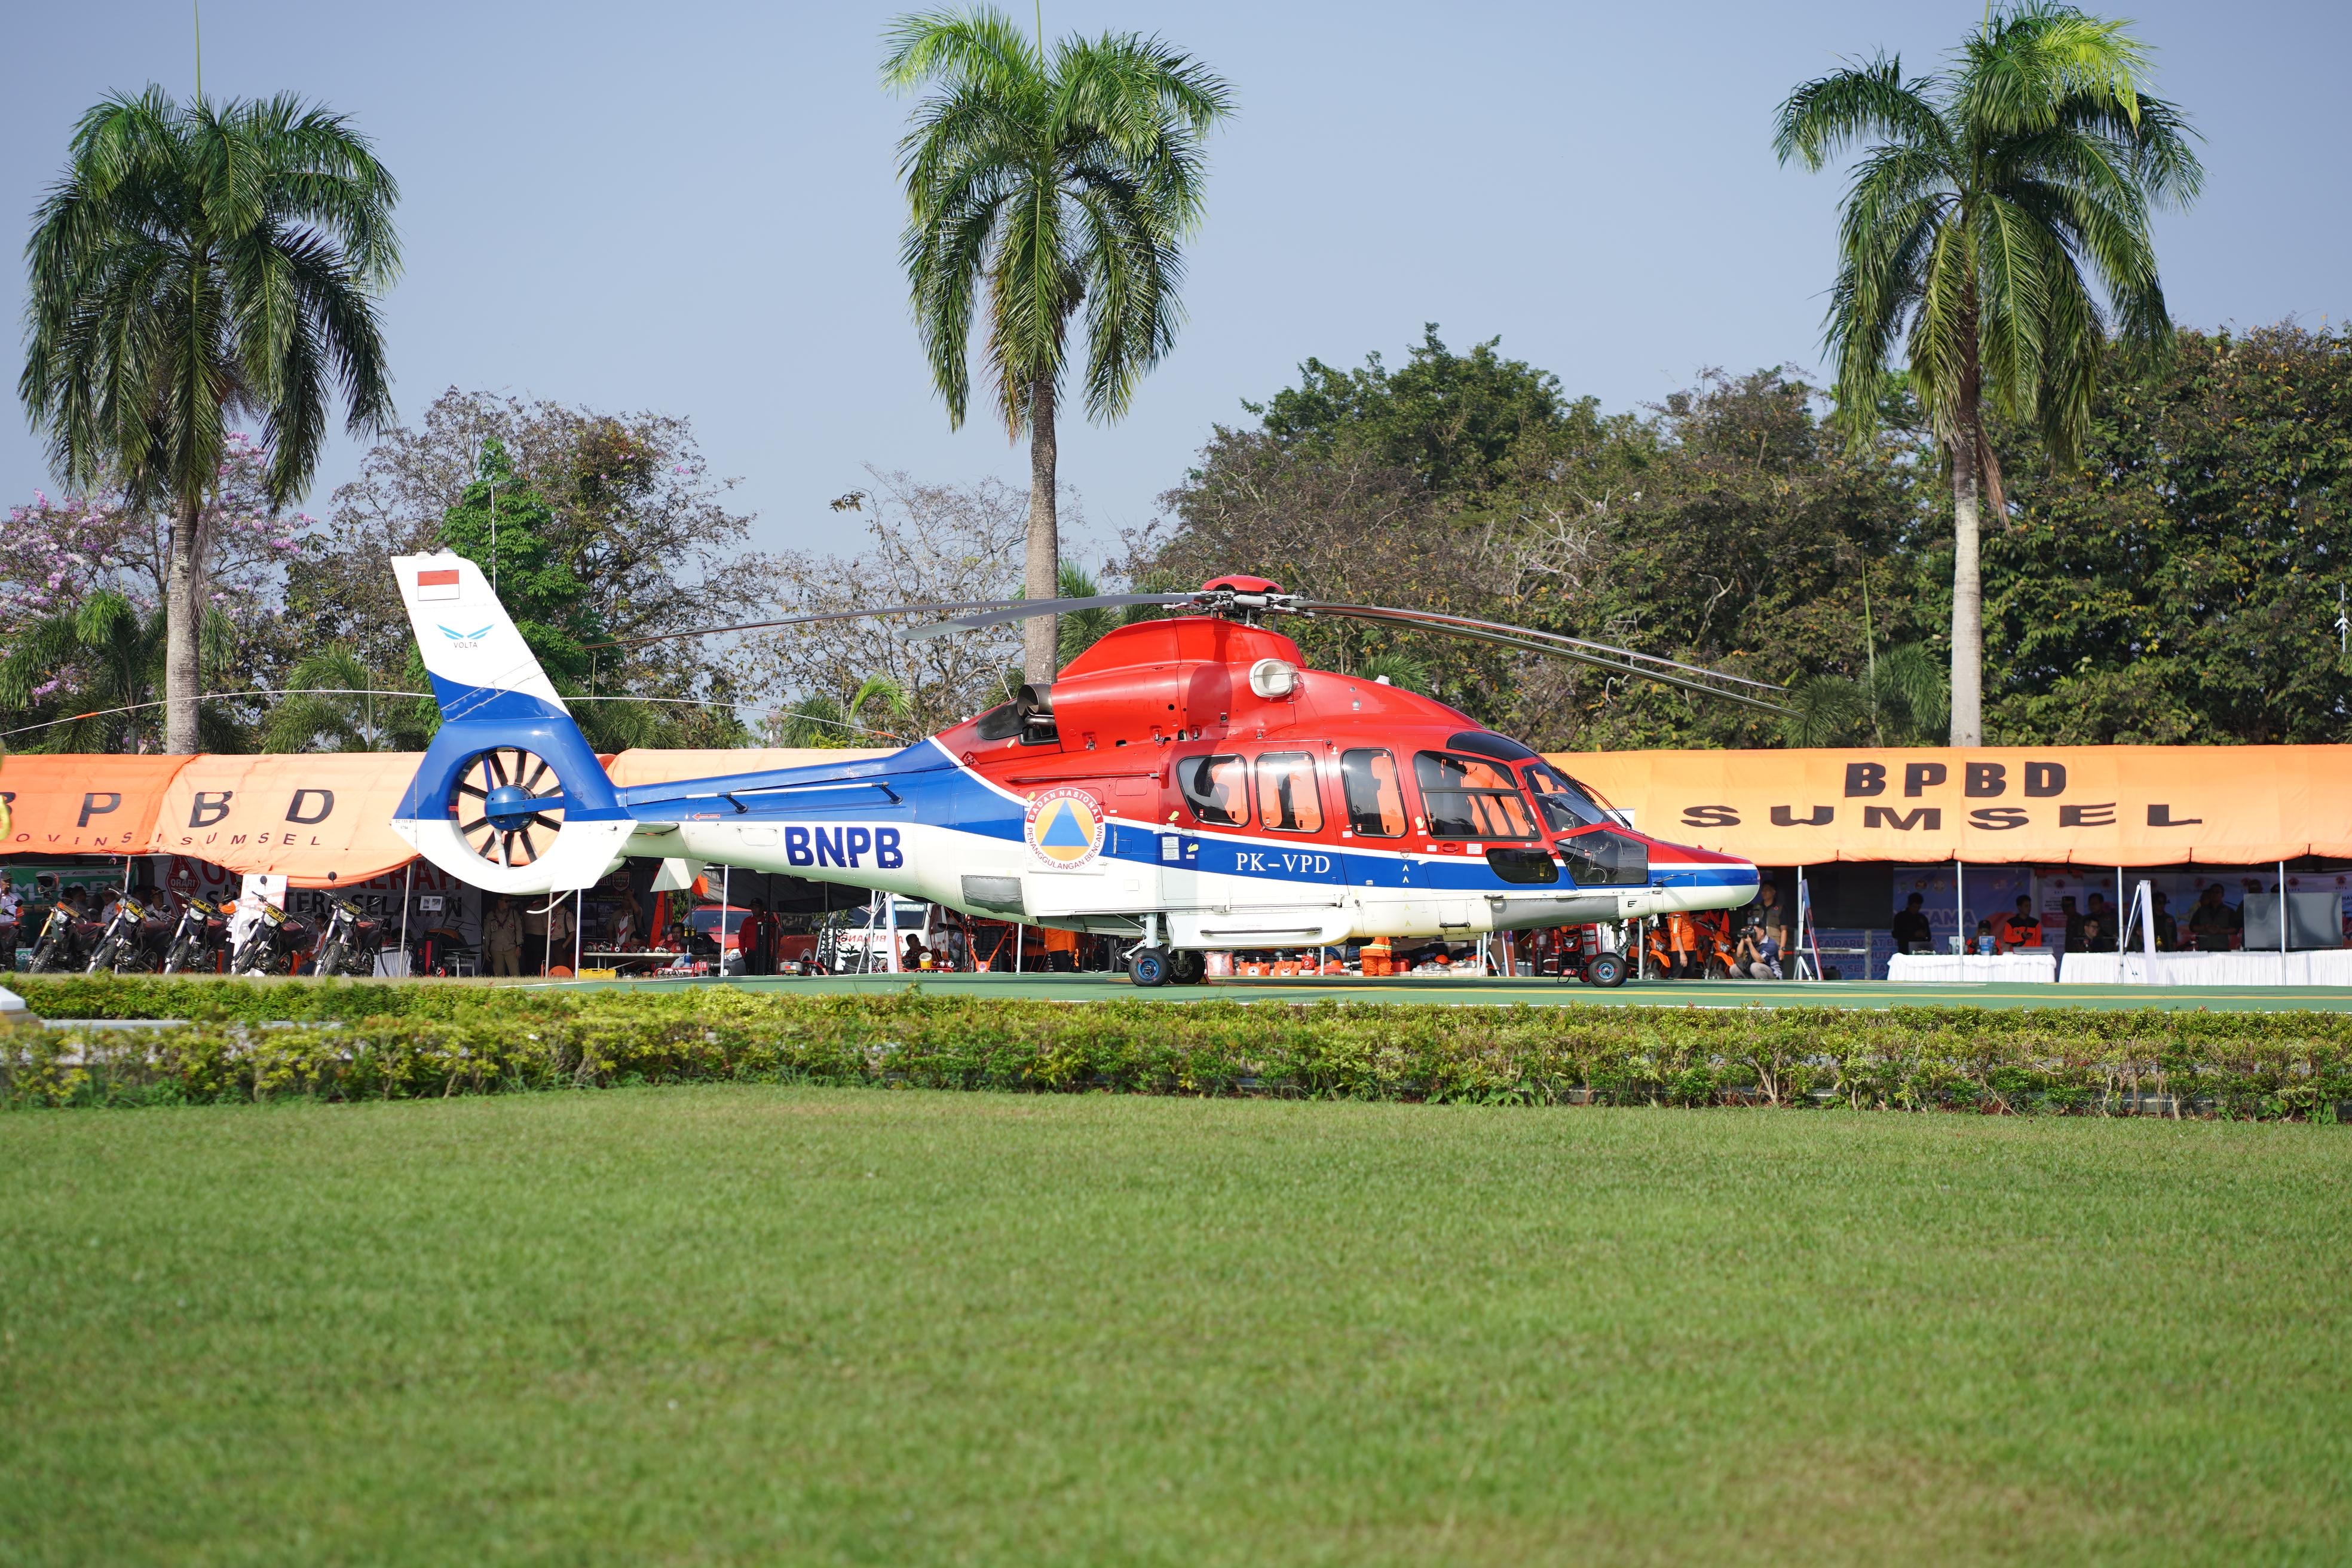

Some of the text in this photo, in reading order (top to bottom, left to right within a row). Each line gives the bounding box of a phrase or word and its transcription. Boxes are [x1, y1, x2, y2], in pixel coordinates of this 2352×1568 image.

[1844, 761, 2067, 798] BPBD
[1029, 789, 1101, 822] BADAN NASIONAL
[1680, 802, 2203, 831] SUMSEL
[785, 826, 904, 869] BNPB
[1027, 825, 1104, 870] PENANGGULANGAN BENCANA
[1235, 852, 1331, 875] PK-VPD
[170, 878, 196, 887] ORARI
[1834, 938, 1884, 948] DARUAT
